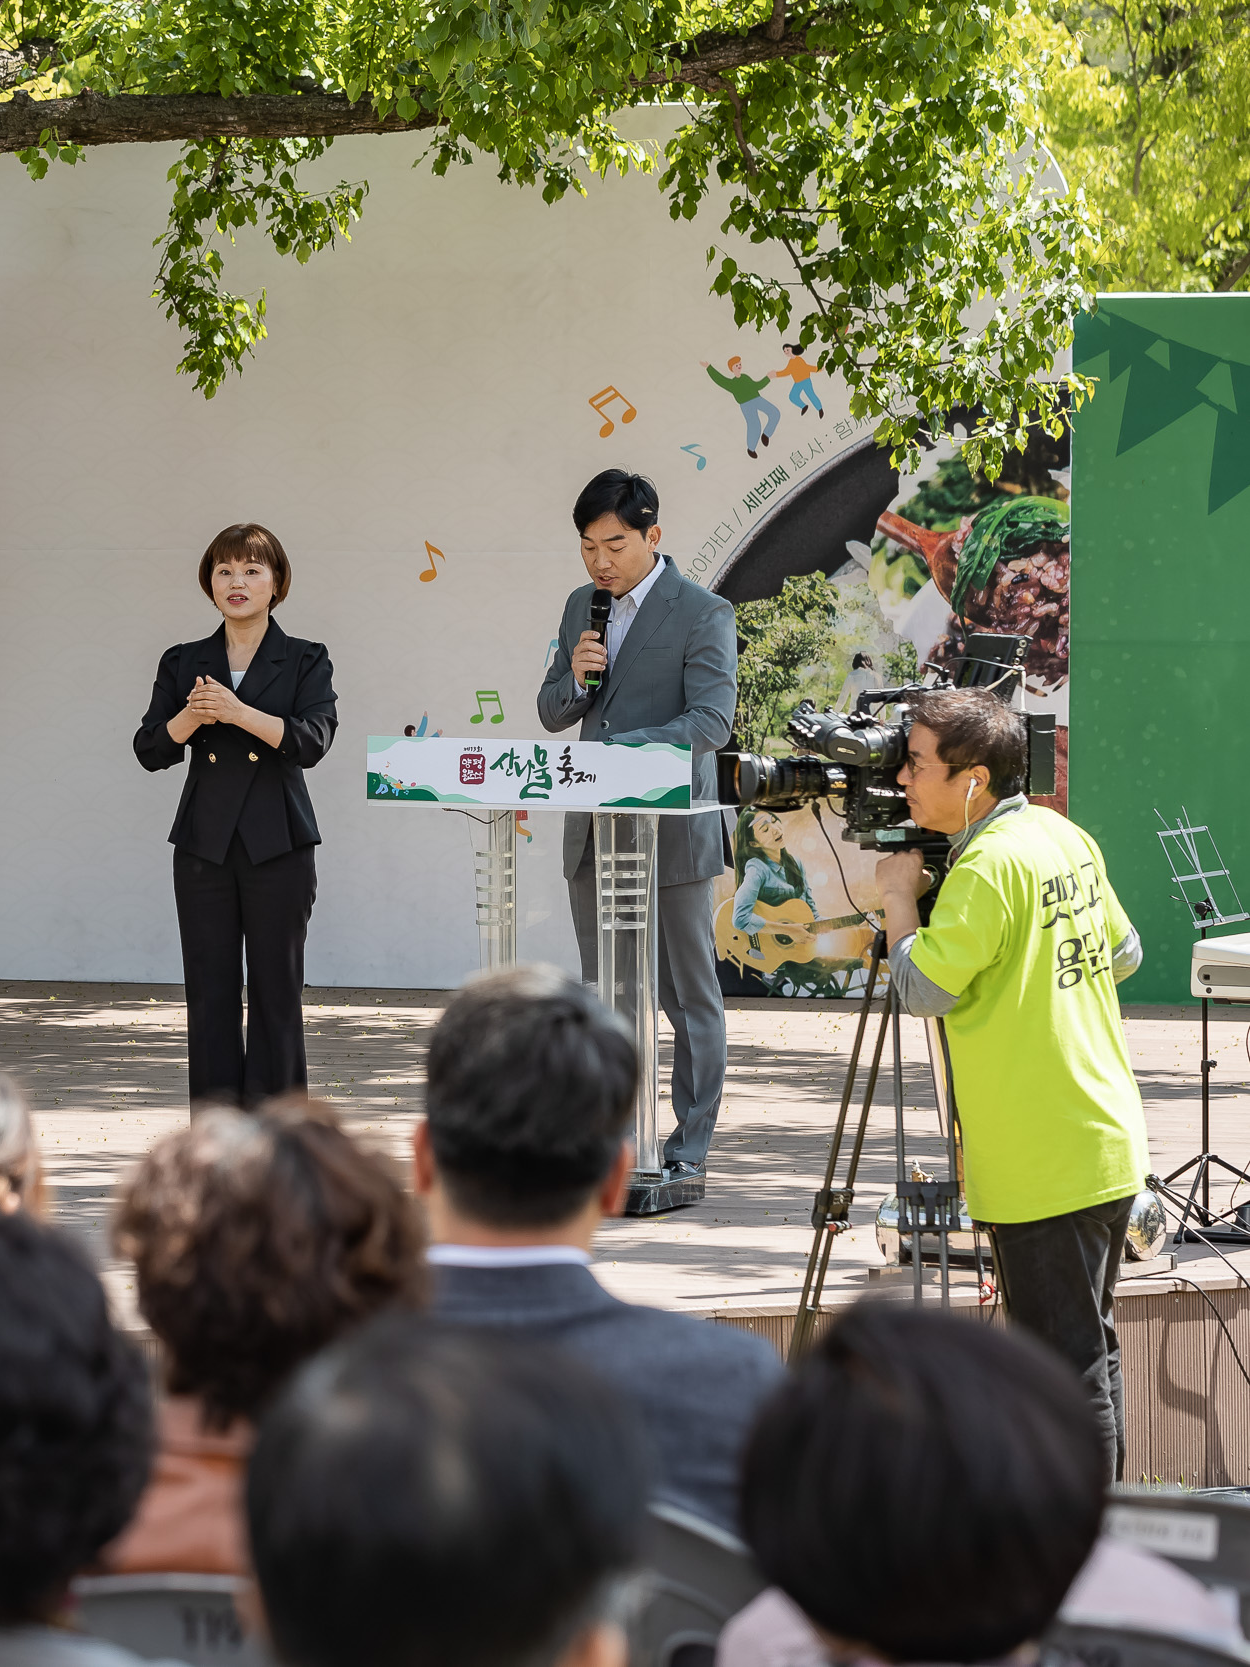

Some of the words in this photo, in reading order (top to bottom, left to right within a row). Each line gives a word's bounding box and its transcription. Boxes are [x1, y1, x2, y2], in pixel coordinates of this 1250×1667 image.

[742, 464, 791, 514] 세번째
[463, 745, 483, 753] 제13회
[461, 757, 484, 769] 양평
[461, 768, 484, 782] 용문산
[490, 743, 553, 800] 산나물
[556, 745, 597, 788] 축제
